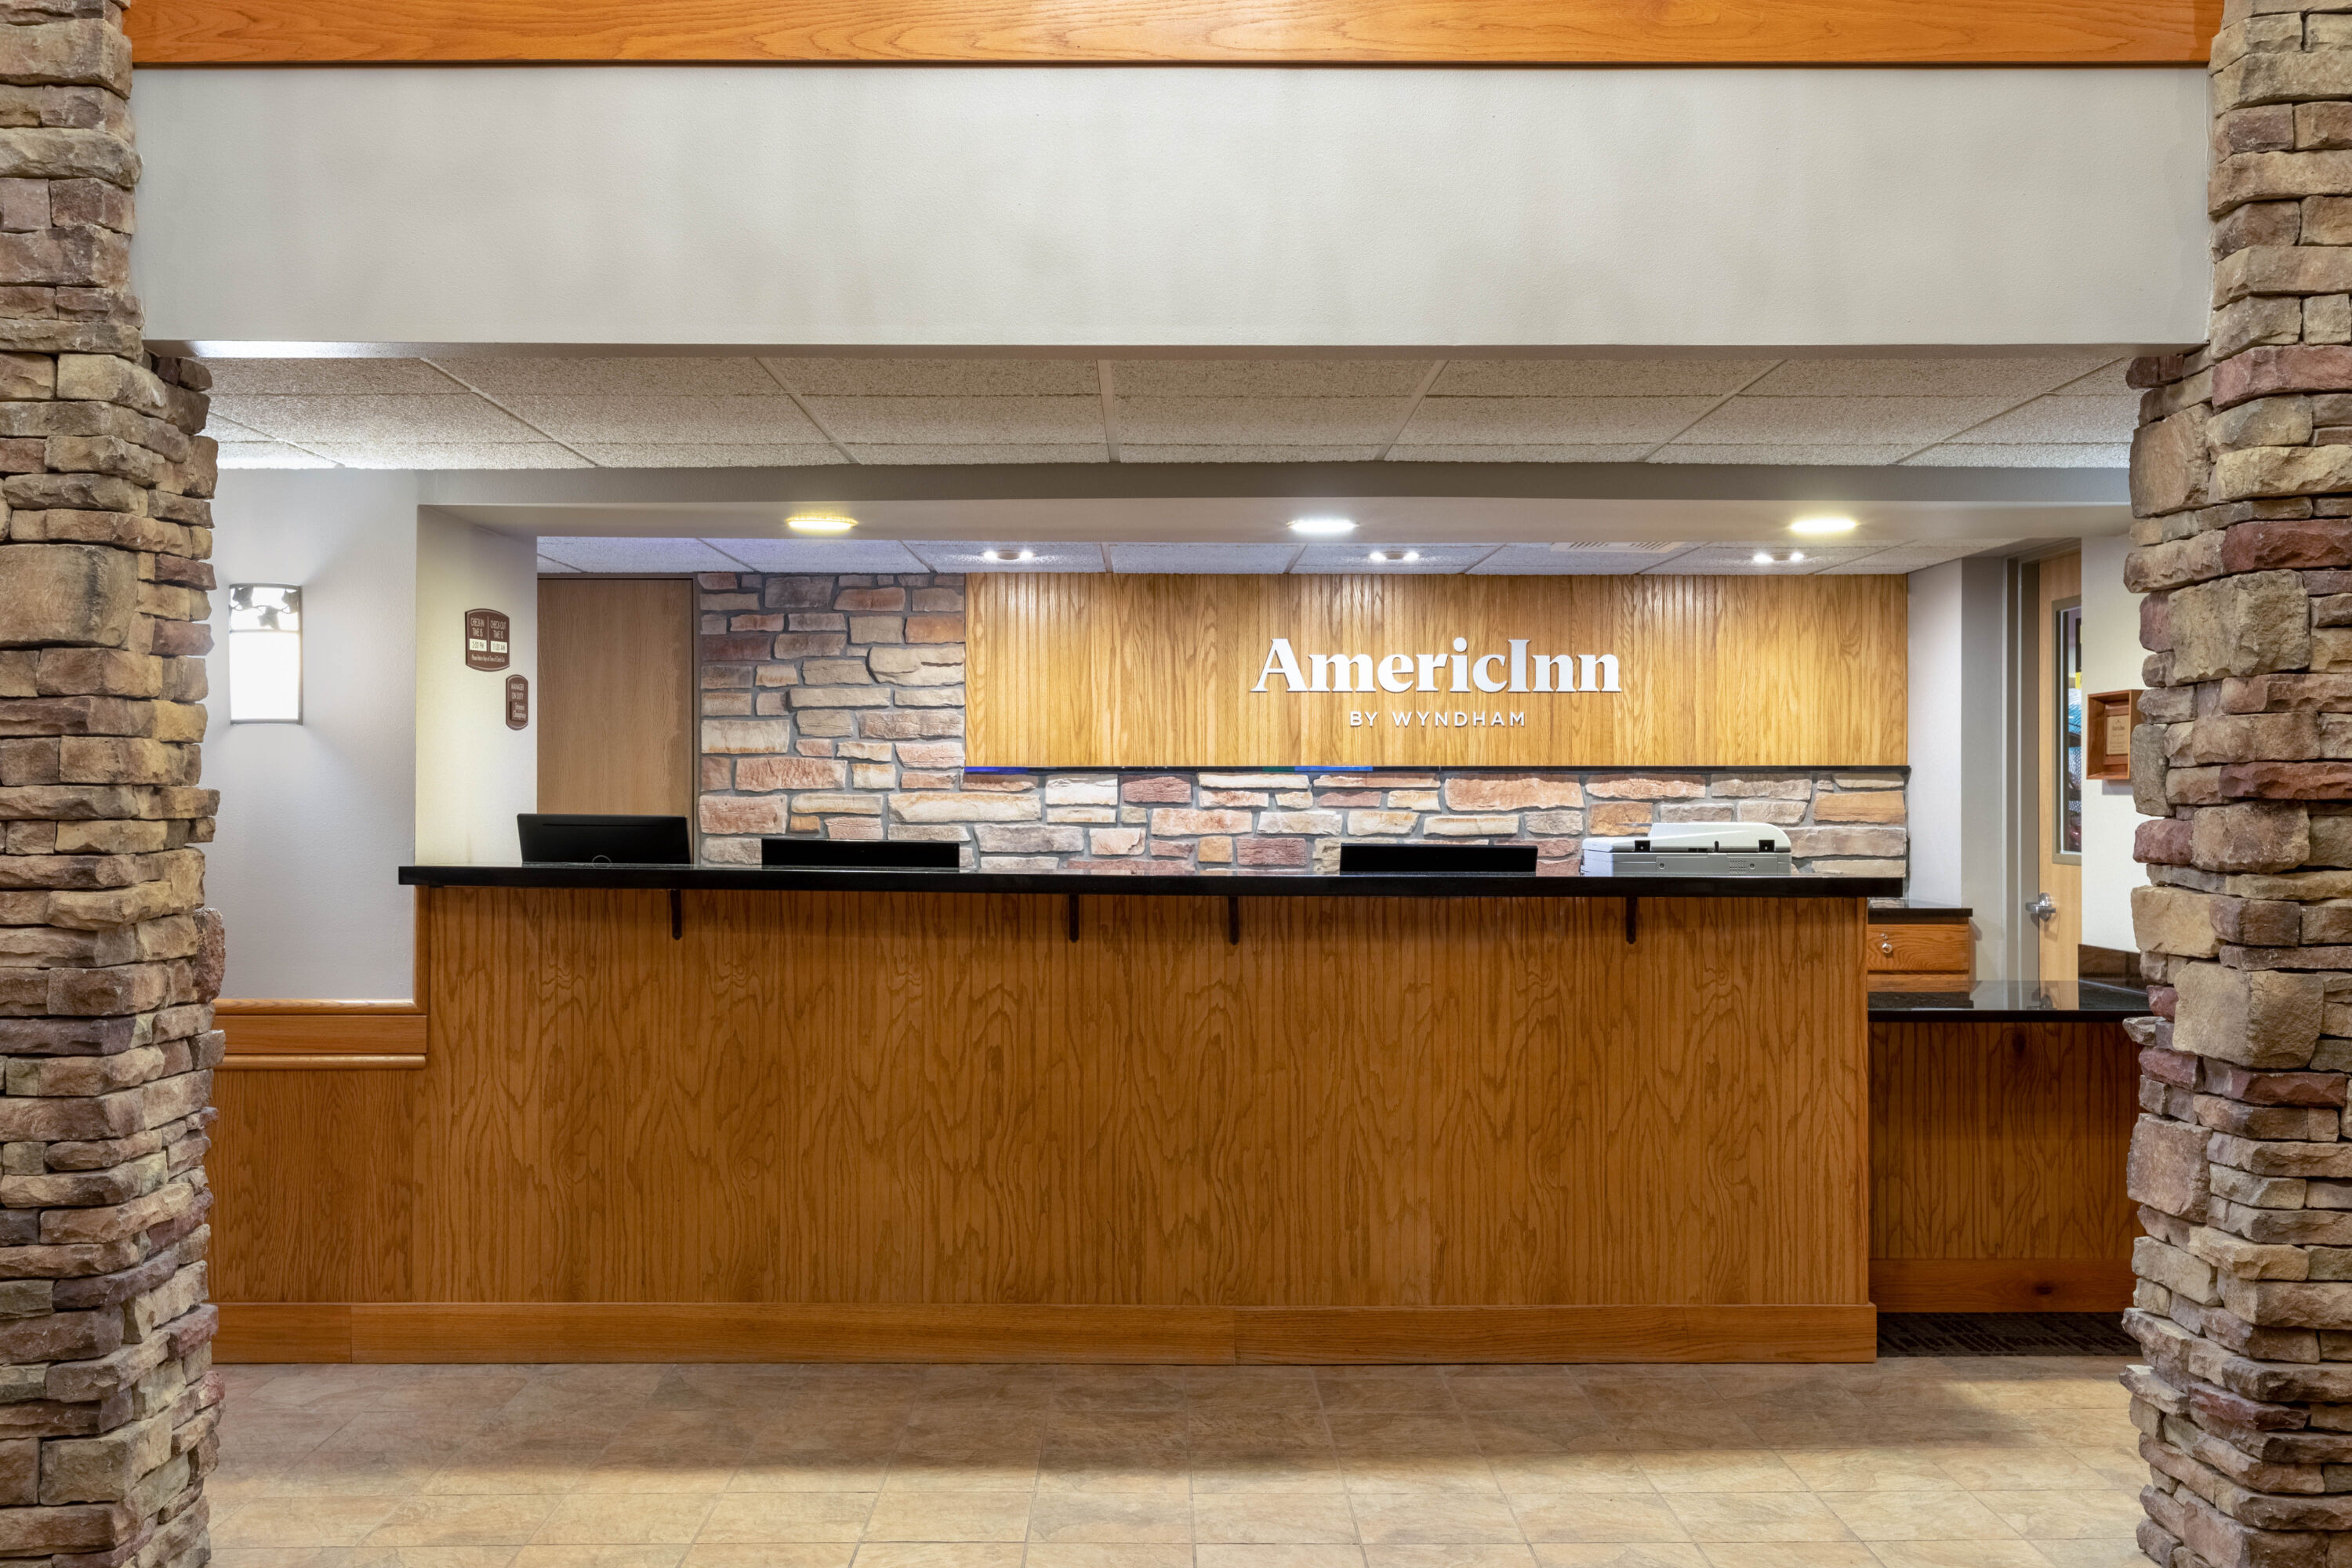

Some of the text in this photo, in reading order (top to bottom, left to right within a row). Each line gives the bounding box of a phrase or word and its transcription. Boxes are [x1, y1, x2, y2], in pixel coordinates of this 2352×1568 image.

[470, 617, 485, 627] CHECK-IN
[490, 619, 506, 630] CHECK-OUT
[480, 628, 483, 637] IS
[501, 630, 504, 639] IS
[1250, 637, 1621, 693] AmericInn
[1349, 711, 1525, 728] BY WYNDHAM
